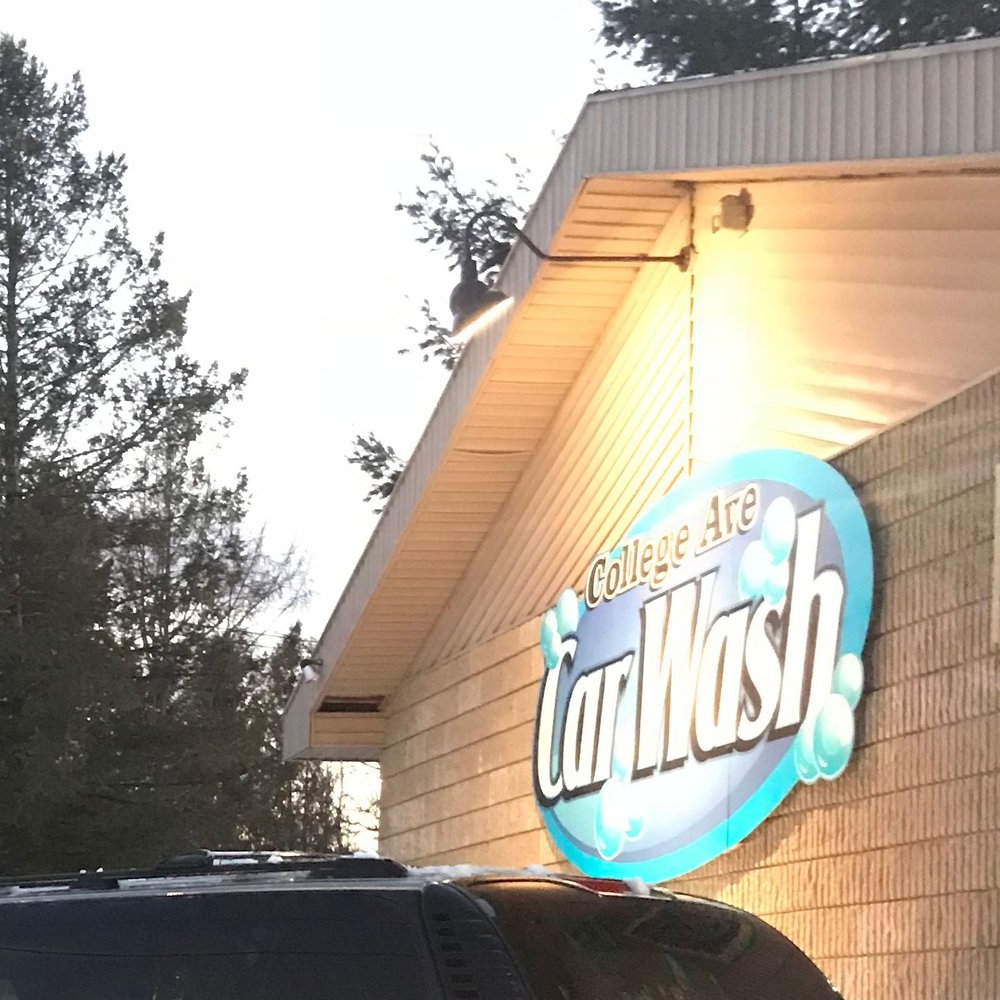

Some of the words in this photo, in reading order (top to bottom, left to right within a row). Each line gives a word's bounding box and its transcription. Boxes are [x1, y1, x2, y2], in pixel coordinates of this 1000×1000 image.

[534, 634, 636, 805] Car
[630, 503, 846, 780] Wash
[586, 523, 691, 606] College
